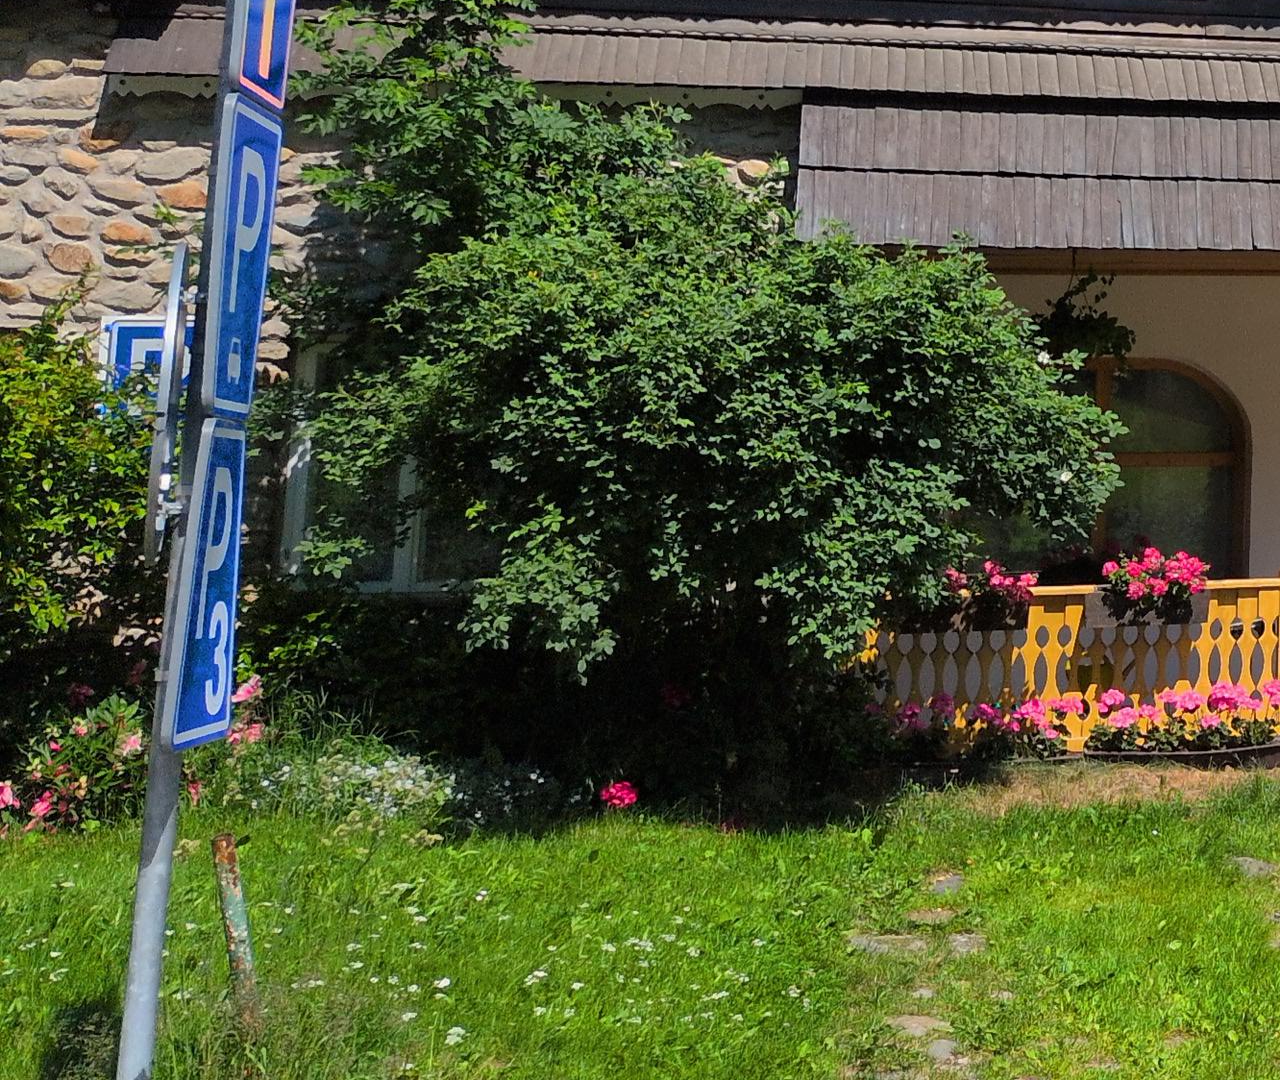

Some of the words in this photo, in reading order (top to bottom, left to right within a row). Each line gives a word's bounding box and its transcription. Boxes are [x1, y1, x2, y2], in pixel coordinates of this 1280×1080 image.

[229, 145, 266, 313] P
[196, 466, 233, 640] P
[205, 600, 229, 716] 3
